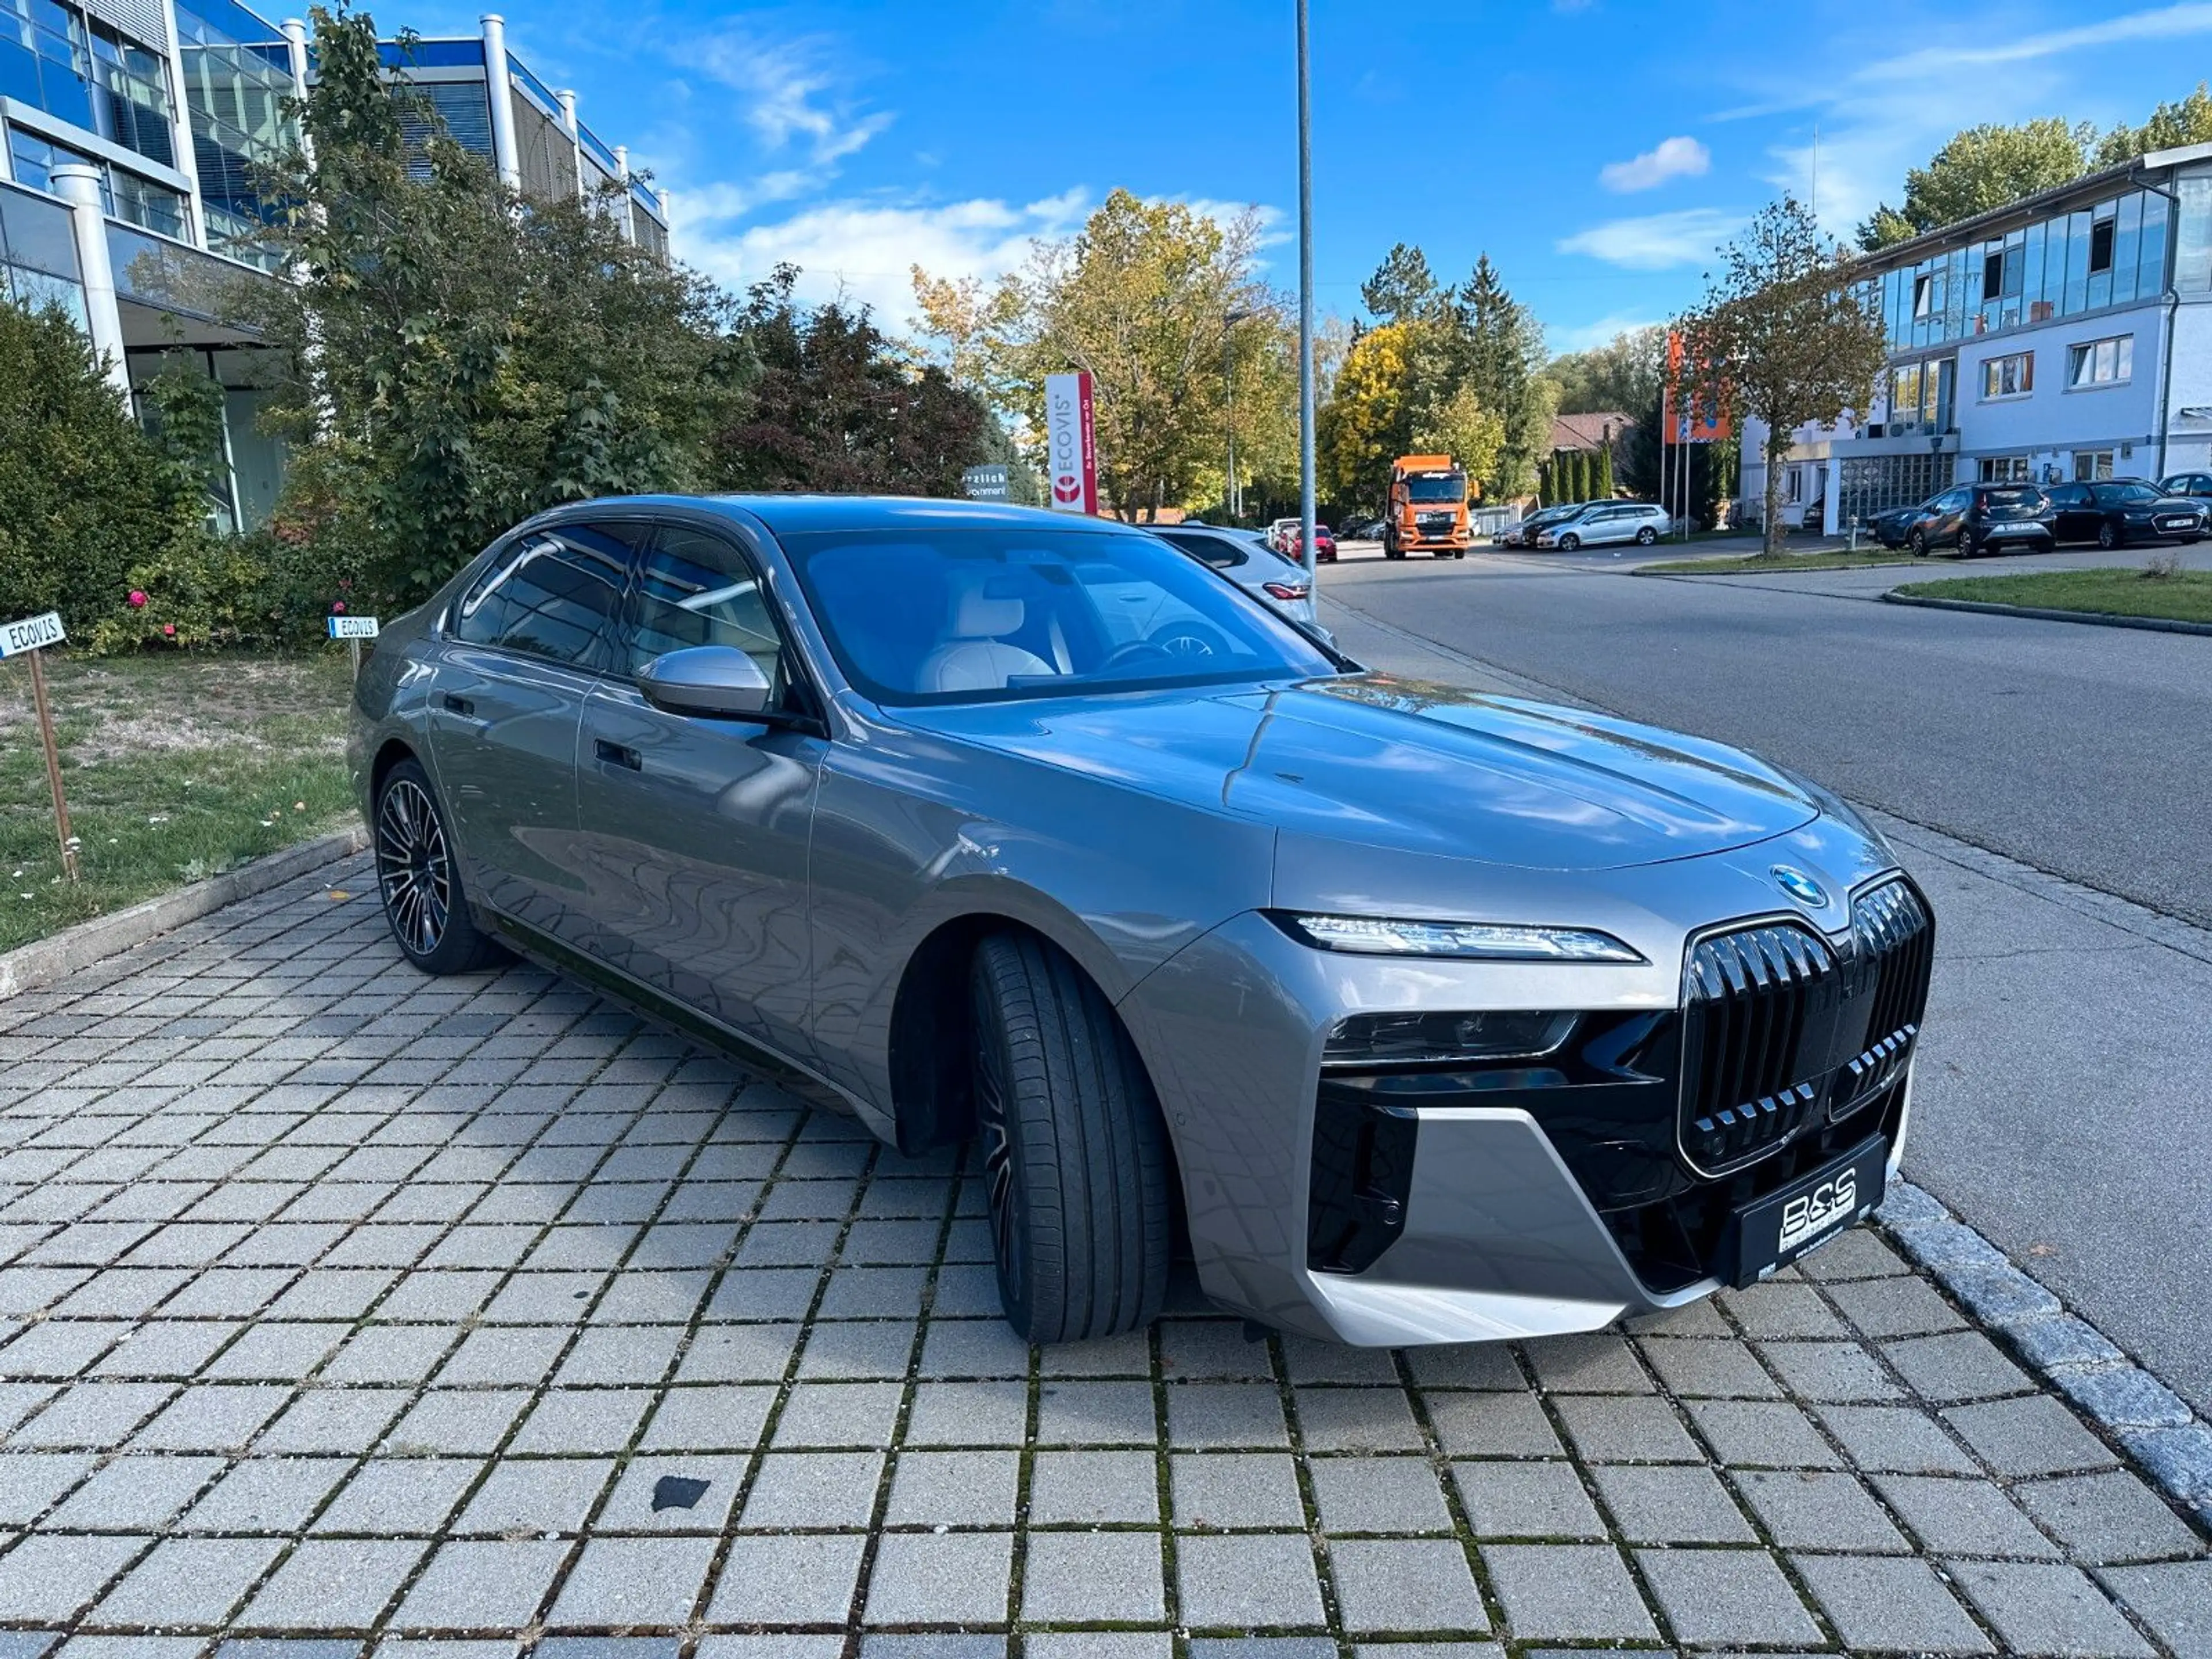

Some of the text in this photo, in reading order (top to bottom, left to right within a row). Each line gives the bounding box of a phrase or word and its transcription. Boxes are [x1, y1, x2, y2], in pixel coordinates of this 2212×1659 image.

[1055, 399, 1074, 471] ECOVIS
[8, 618, 58, 650] ECOVIS
[342, 620, 373, 635] ECOVIS
[1783, 1167, 1856, 1237] B&S
